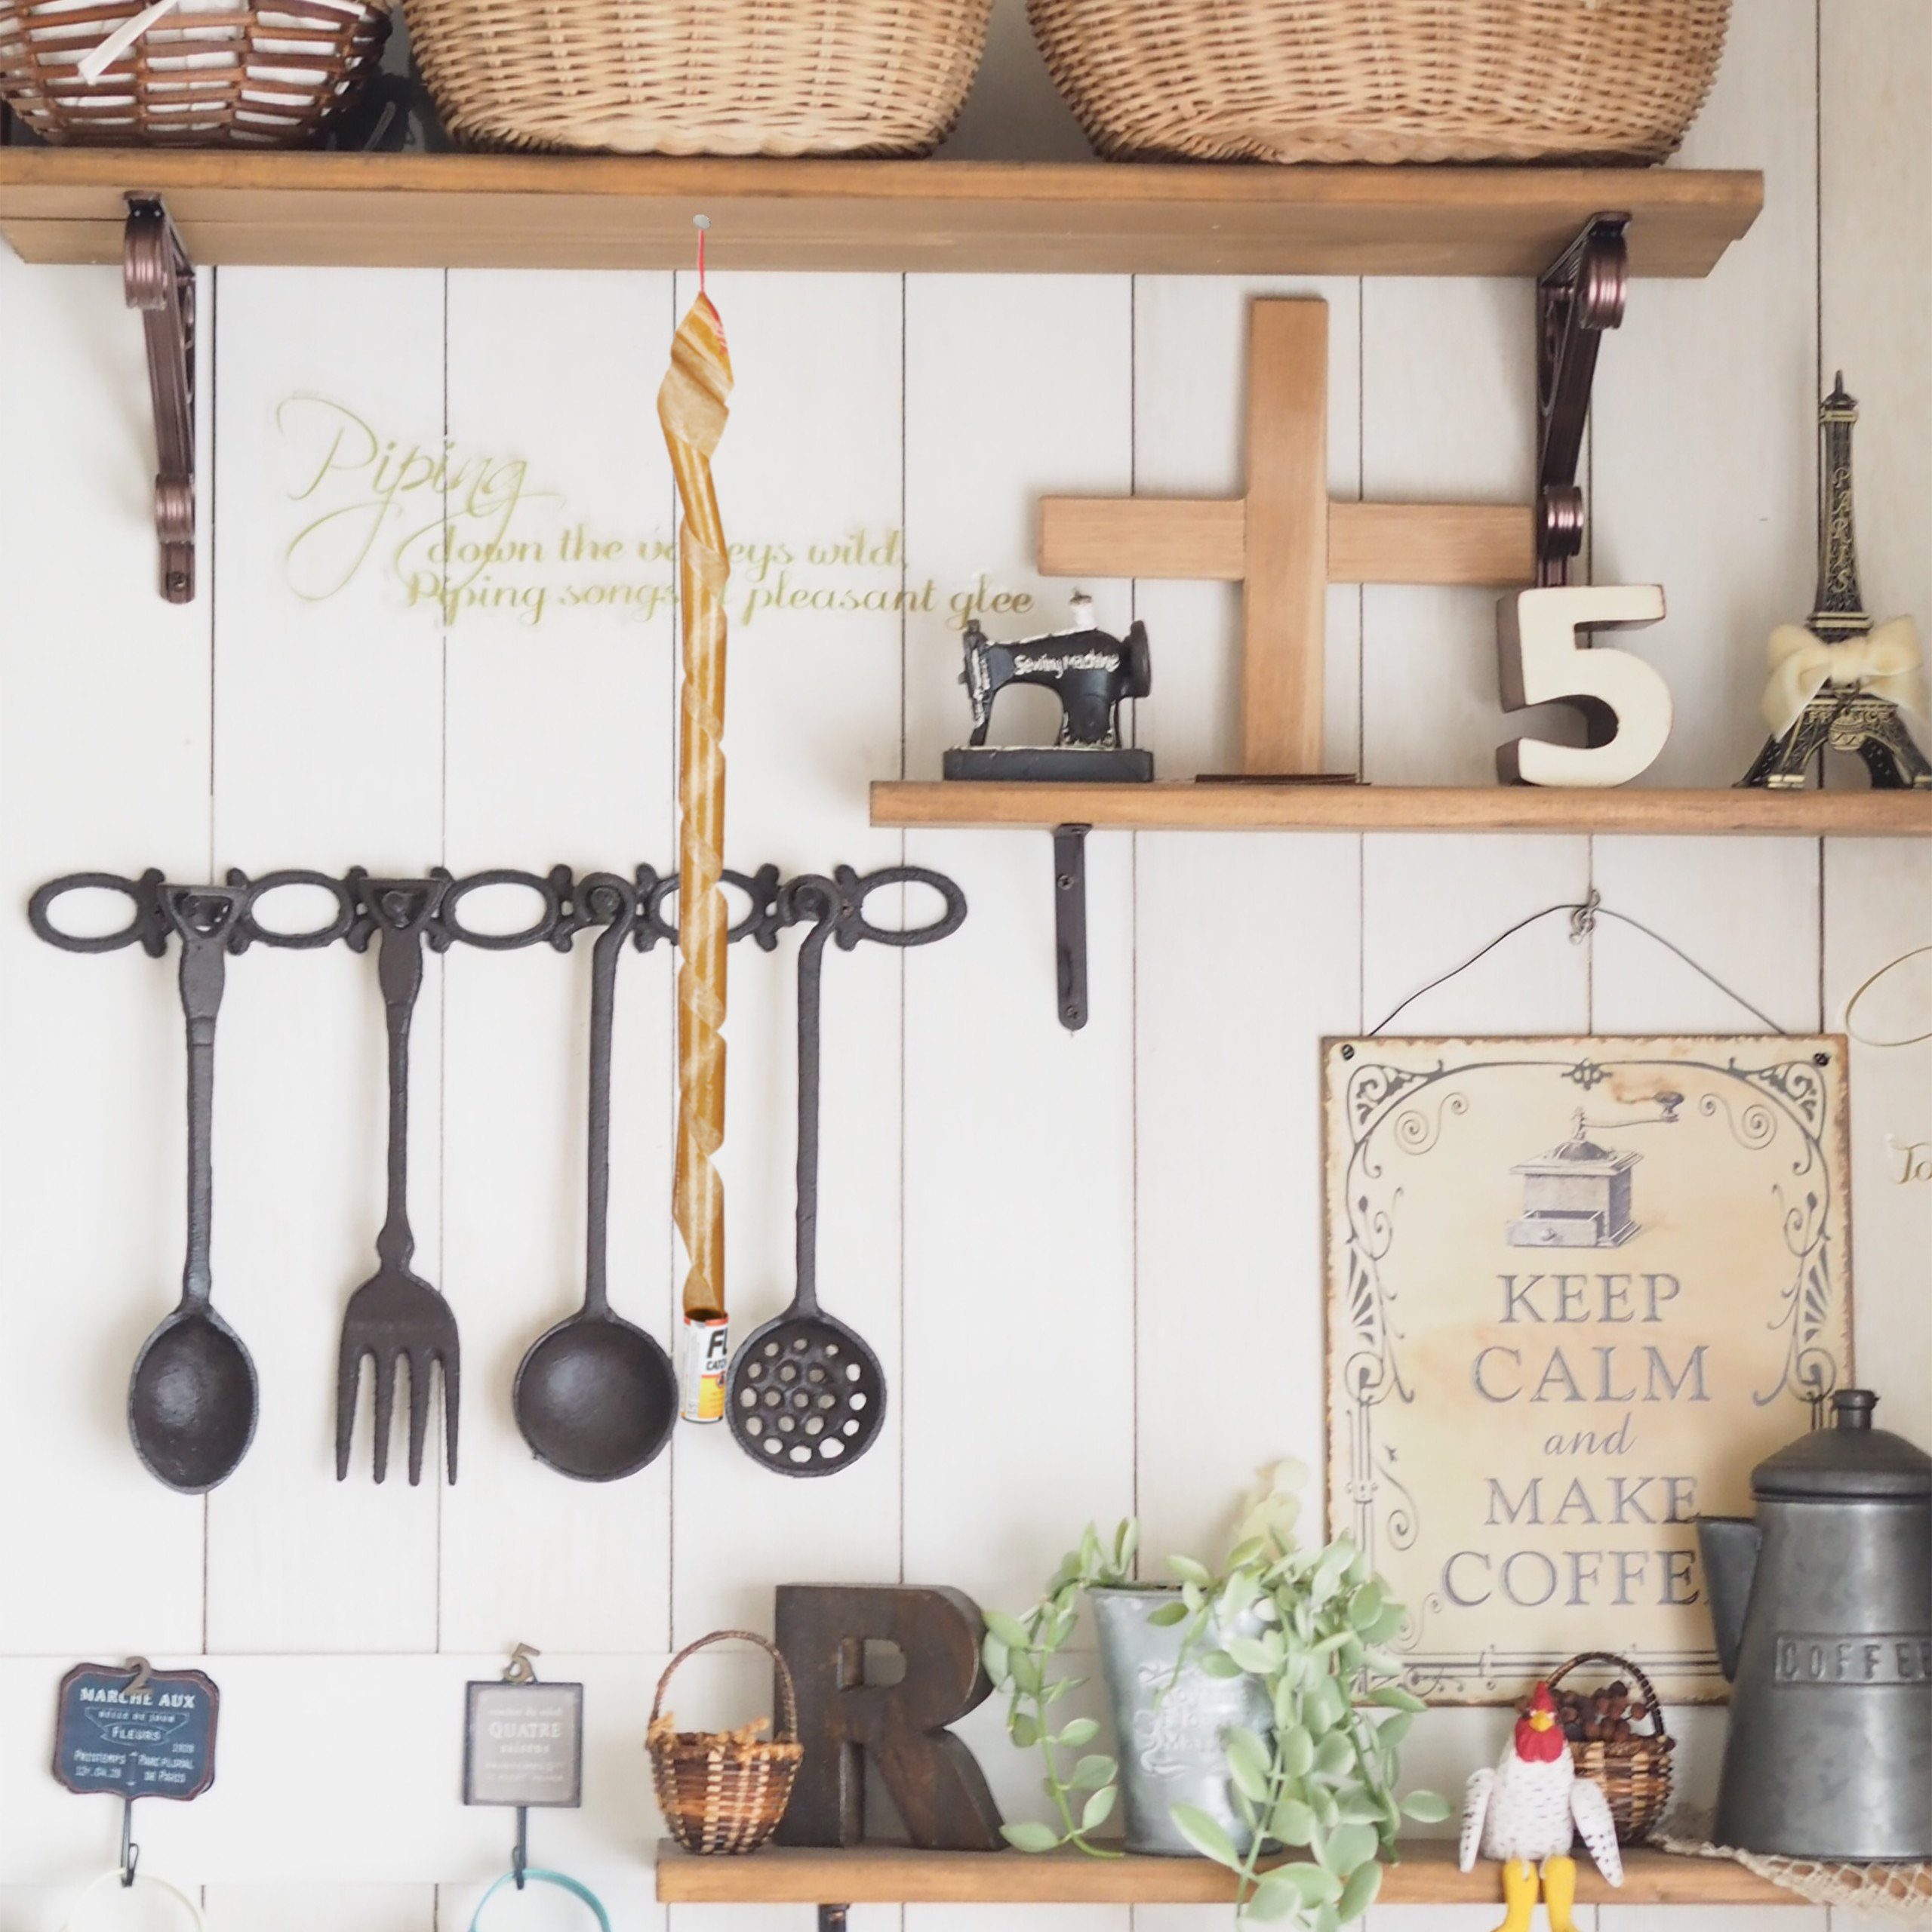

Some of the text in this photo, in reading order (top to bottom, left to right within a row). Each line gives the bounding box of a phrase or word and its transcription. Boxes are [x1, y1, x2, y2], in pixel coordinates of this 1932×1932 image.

[276, 395, 568, 601] Piping
[428, 525, 543, 563] down
[560, 524, 624, 561] the
[636, 540, 792, 582] vaeys
[558, 583, 680, 623] songs
[742, 568, 939, 626] pleasant
[945, 572, 1035, 630] glee
[1497, 583, 1674, 789] 5
[1497, 1272, 1681, 1324] KEEP
[1471, 1345, 1712, 1403] CALM
[1543, 1412, 1637, 1456] and
[1484, 1476, 1701, 1525] MAKE
[1442, 1550, 1711, 1607] COFFE
[158, 1694, 195, 1709] AUX
[773, 1583, 1007, 1852] R
